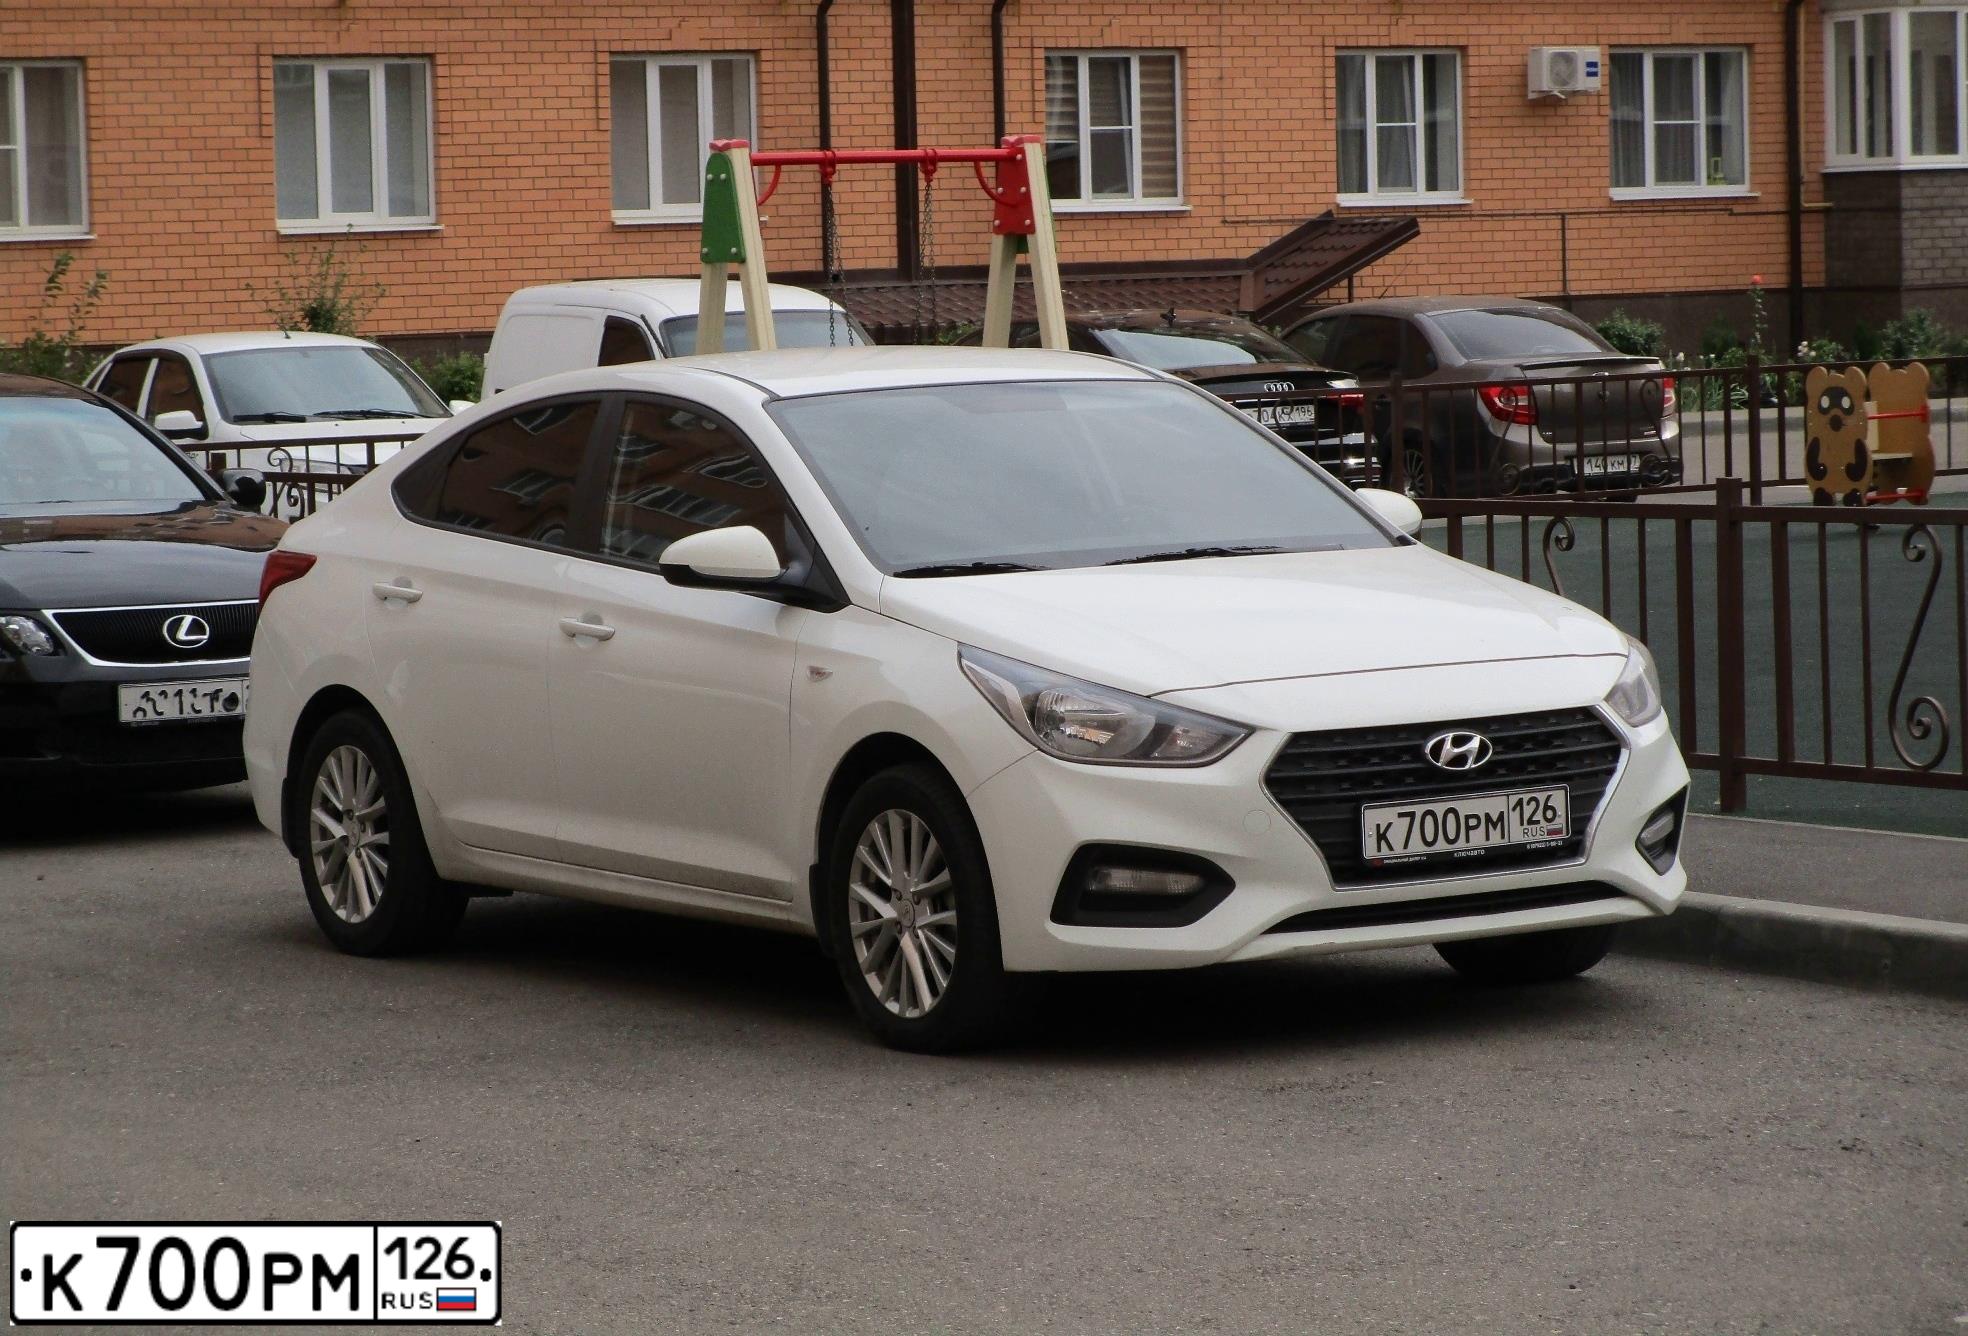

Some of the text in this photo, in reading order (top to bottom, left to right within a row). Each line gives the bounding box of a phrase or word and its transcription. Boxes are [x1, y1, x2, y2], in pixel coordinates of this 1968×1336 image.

[1375, 793, 1558, 853] К700РМ 126
[1522, 826, 1546, 839] RUS
